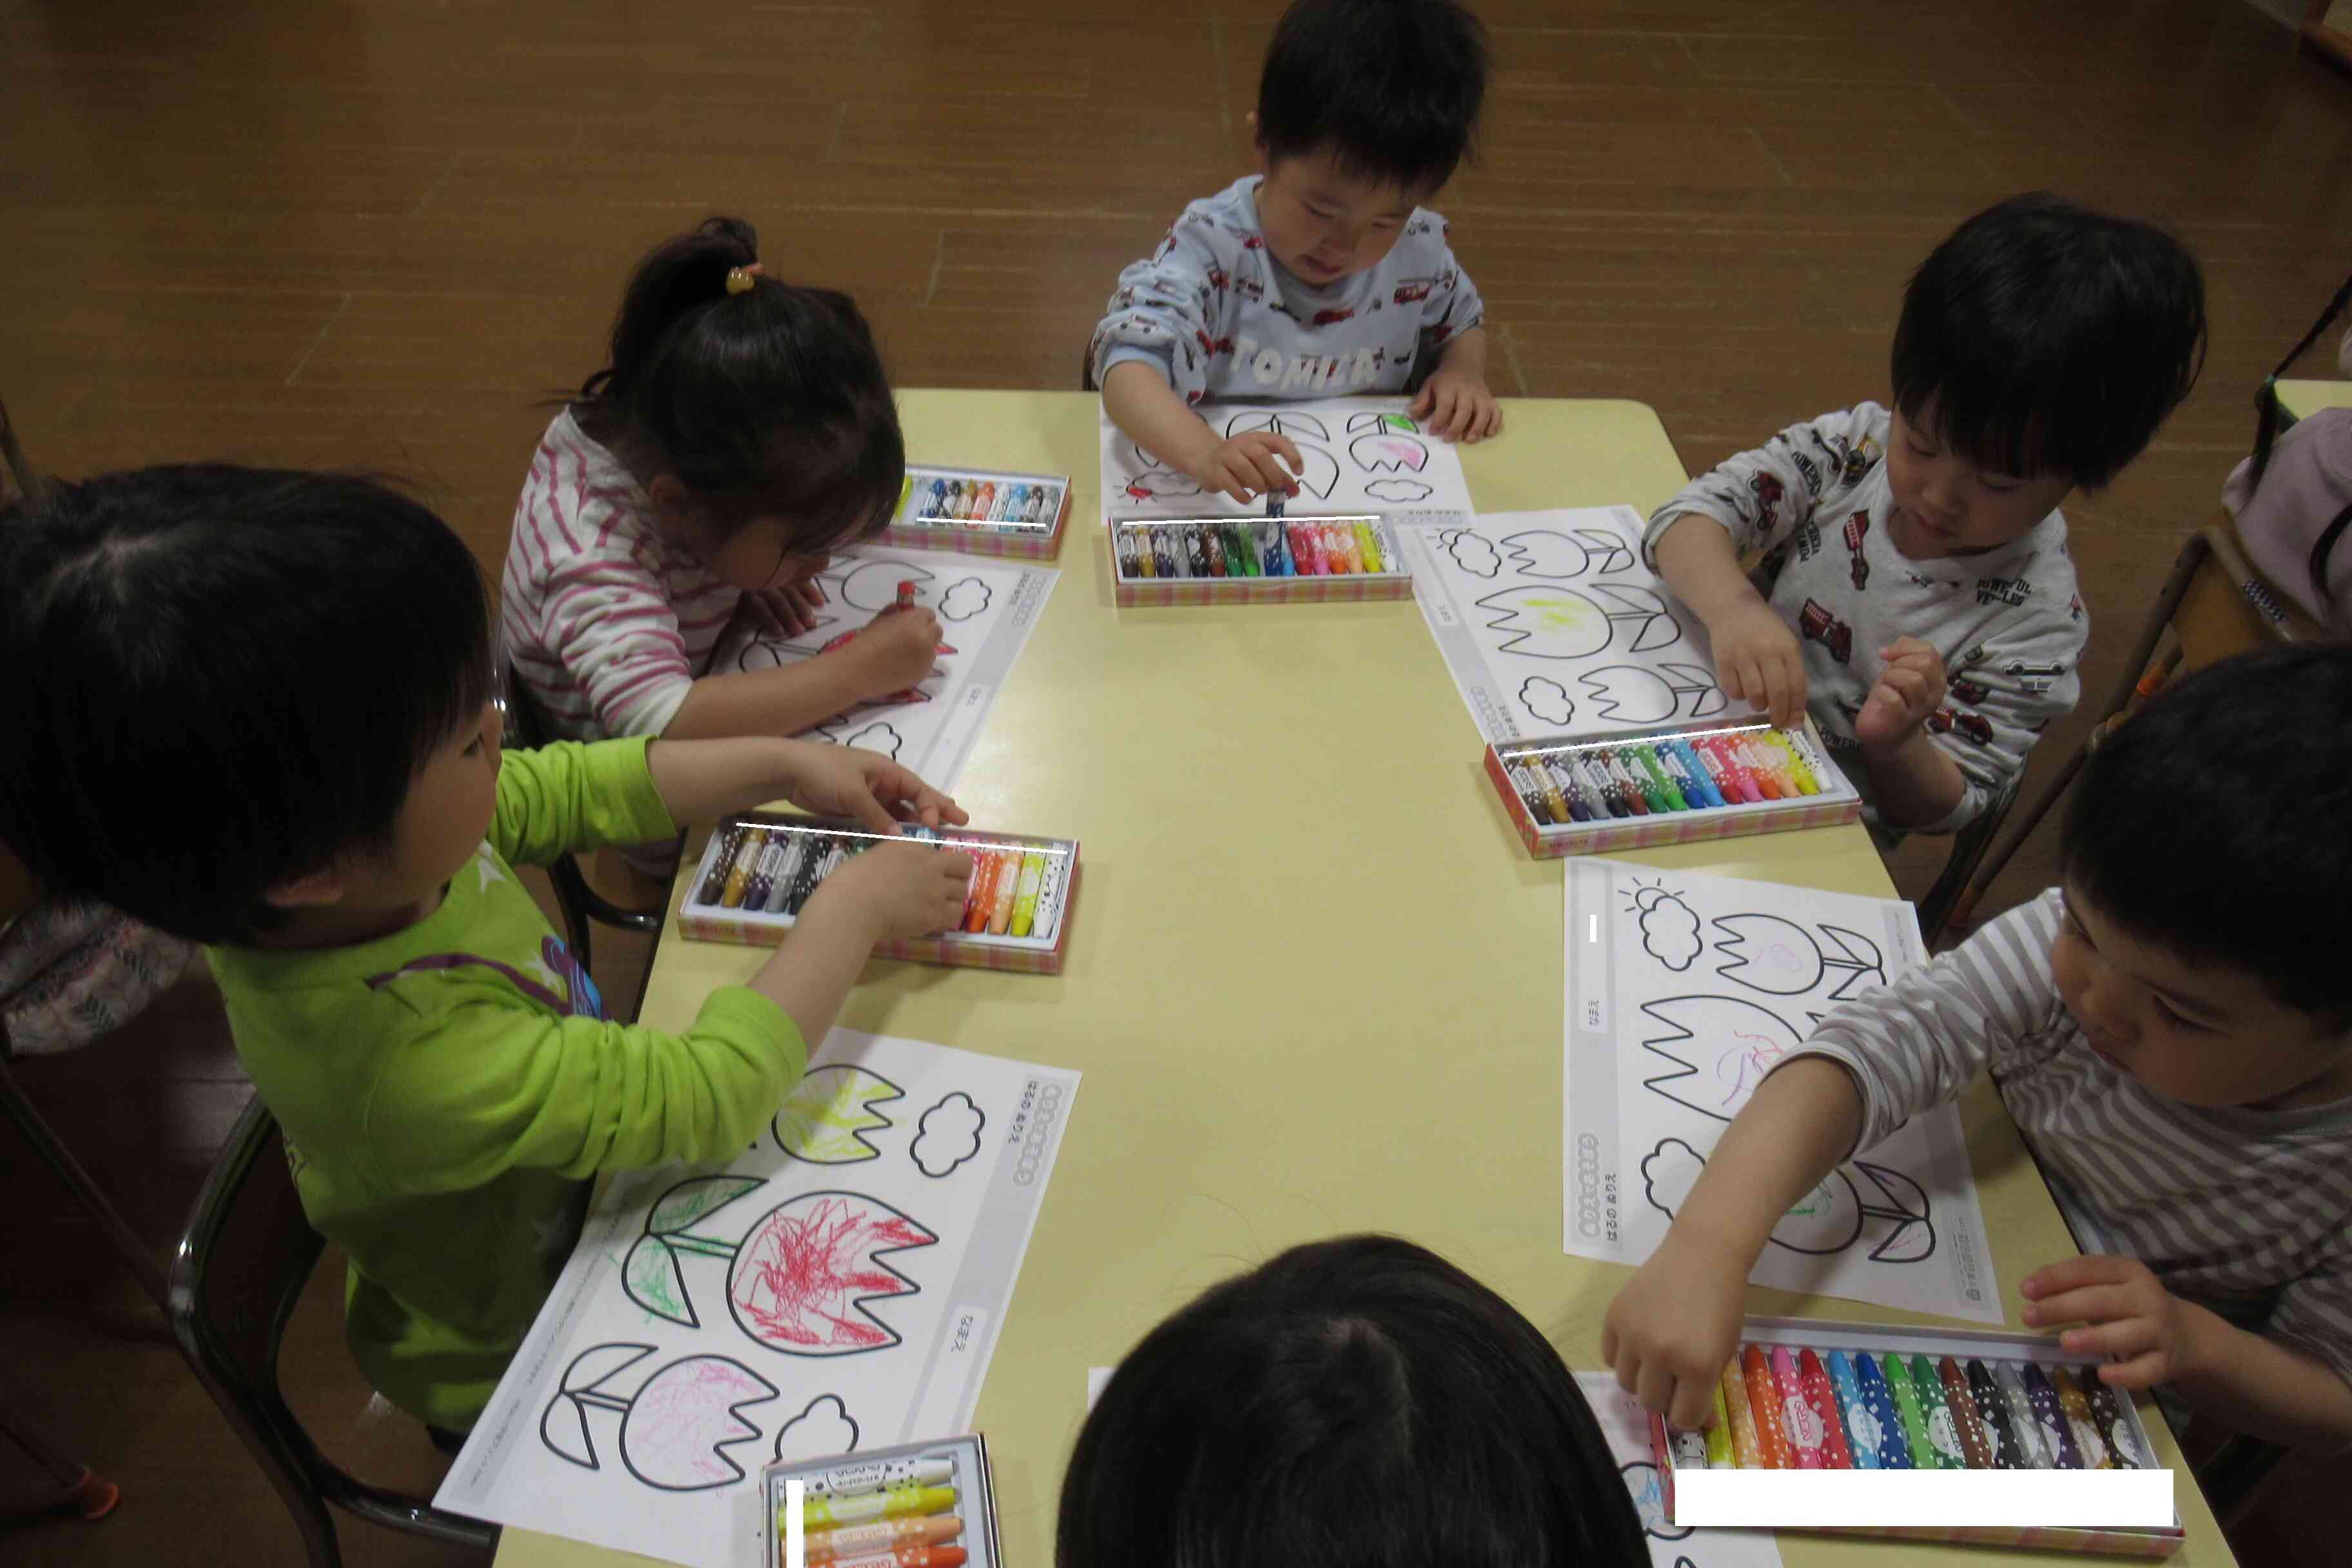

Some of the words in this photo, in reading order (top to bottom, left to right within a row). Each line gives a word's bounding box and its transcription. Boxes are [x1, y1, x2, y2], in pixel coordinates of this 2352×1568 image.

[1588, 1000, 1599, 1026] なまえ
[951, 1315, 974, 1352] なまえ
